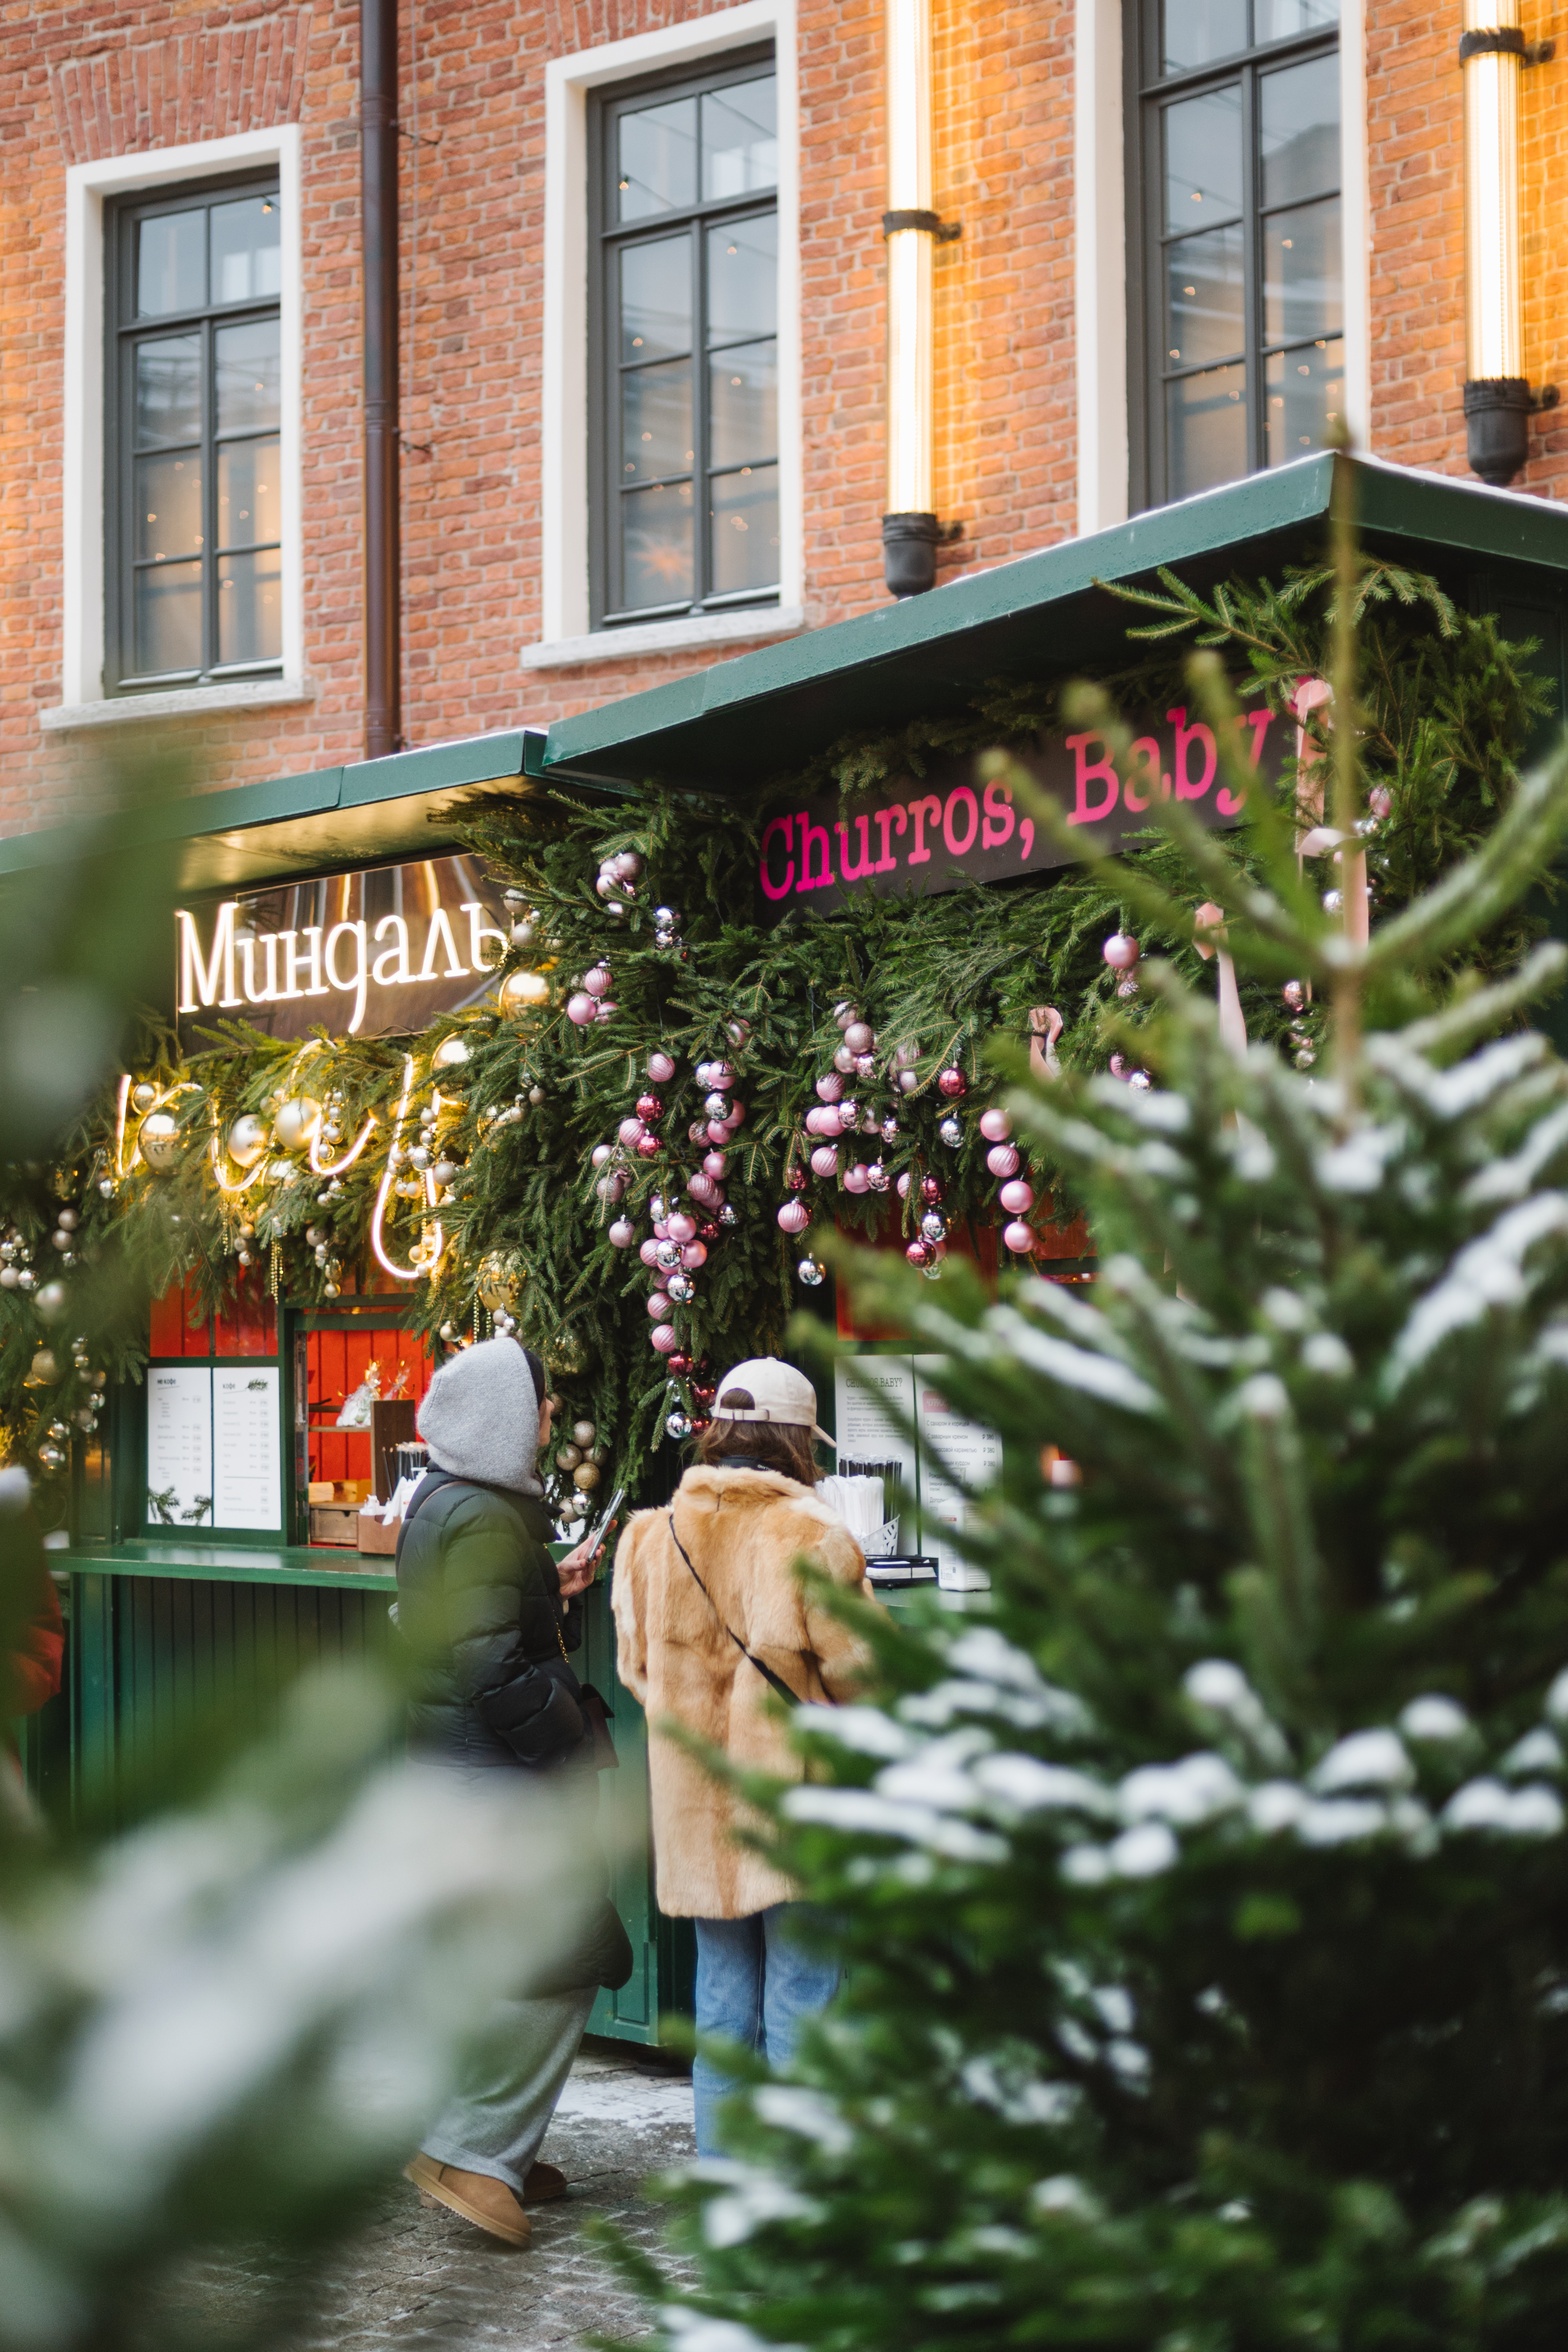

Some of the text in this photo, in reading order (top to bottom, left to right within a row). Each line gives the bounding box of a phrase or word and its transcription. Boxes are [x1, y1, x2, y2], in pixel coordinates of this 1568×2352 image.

[759, 675, 1322, 901] Churros, Baby
[176, 901, 510, 1033] Миндаль
[223, 1382, 236, 1390] кофе
